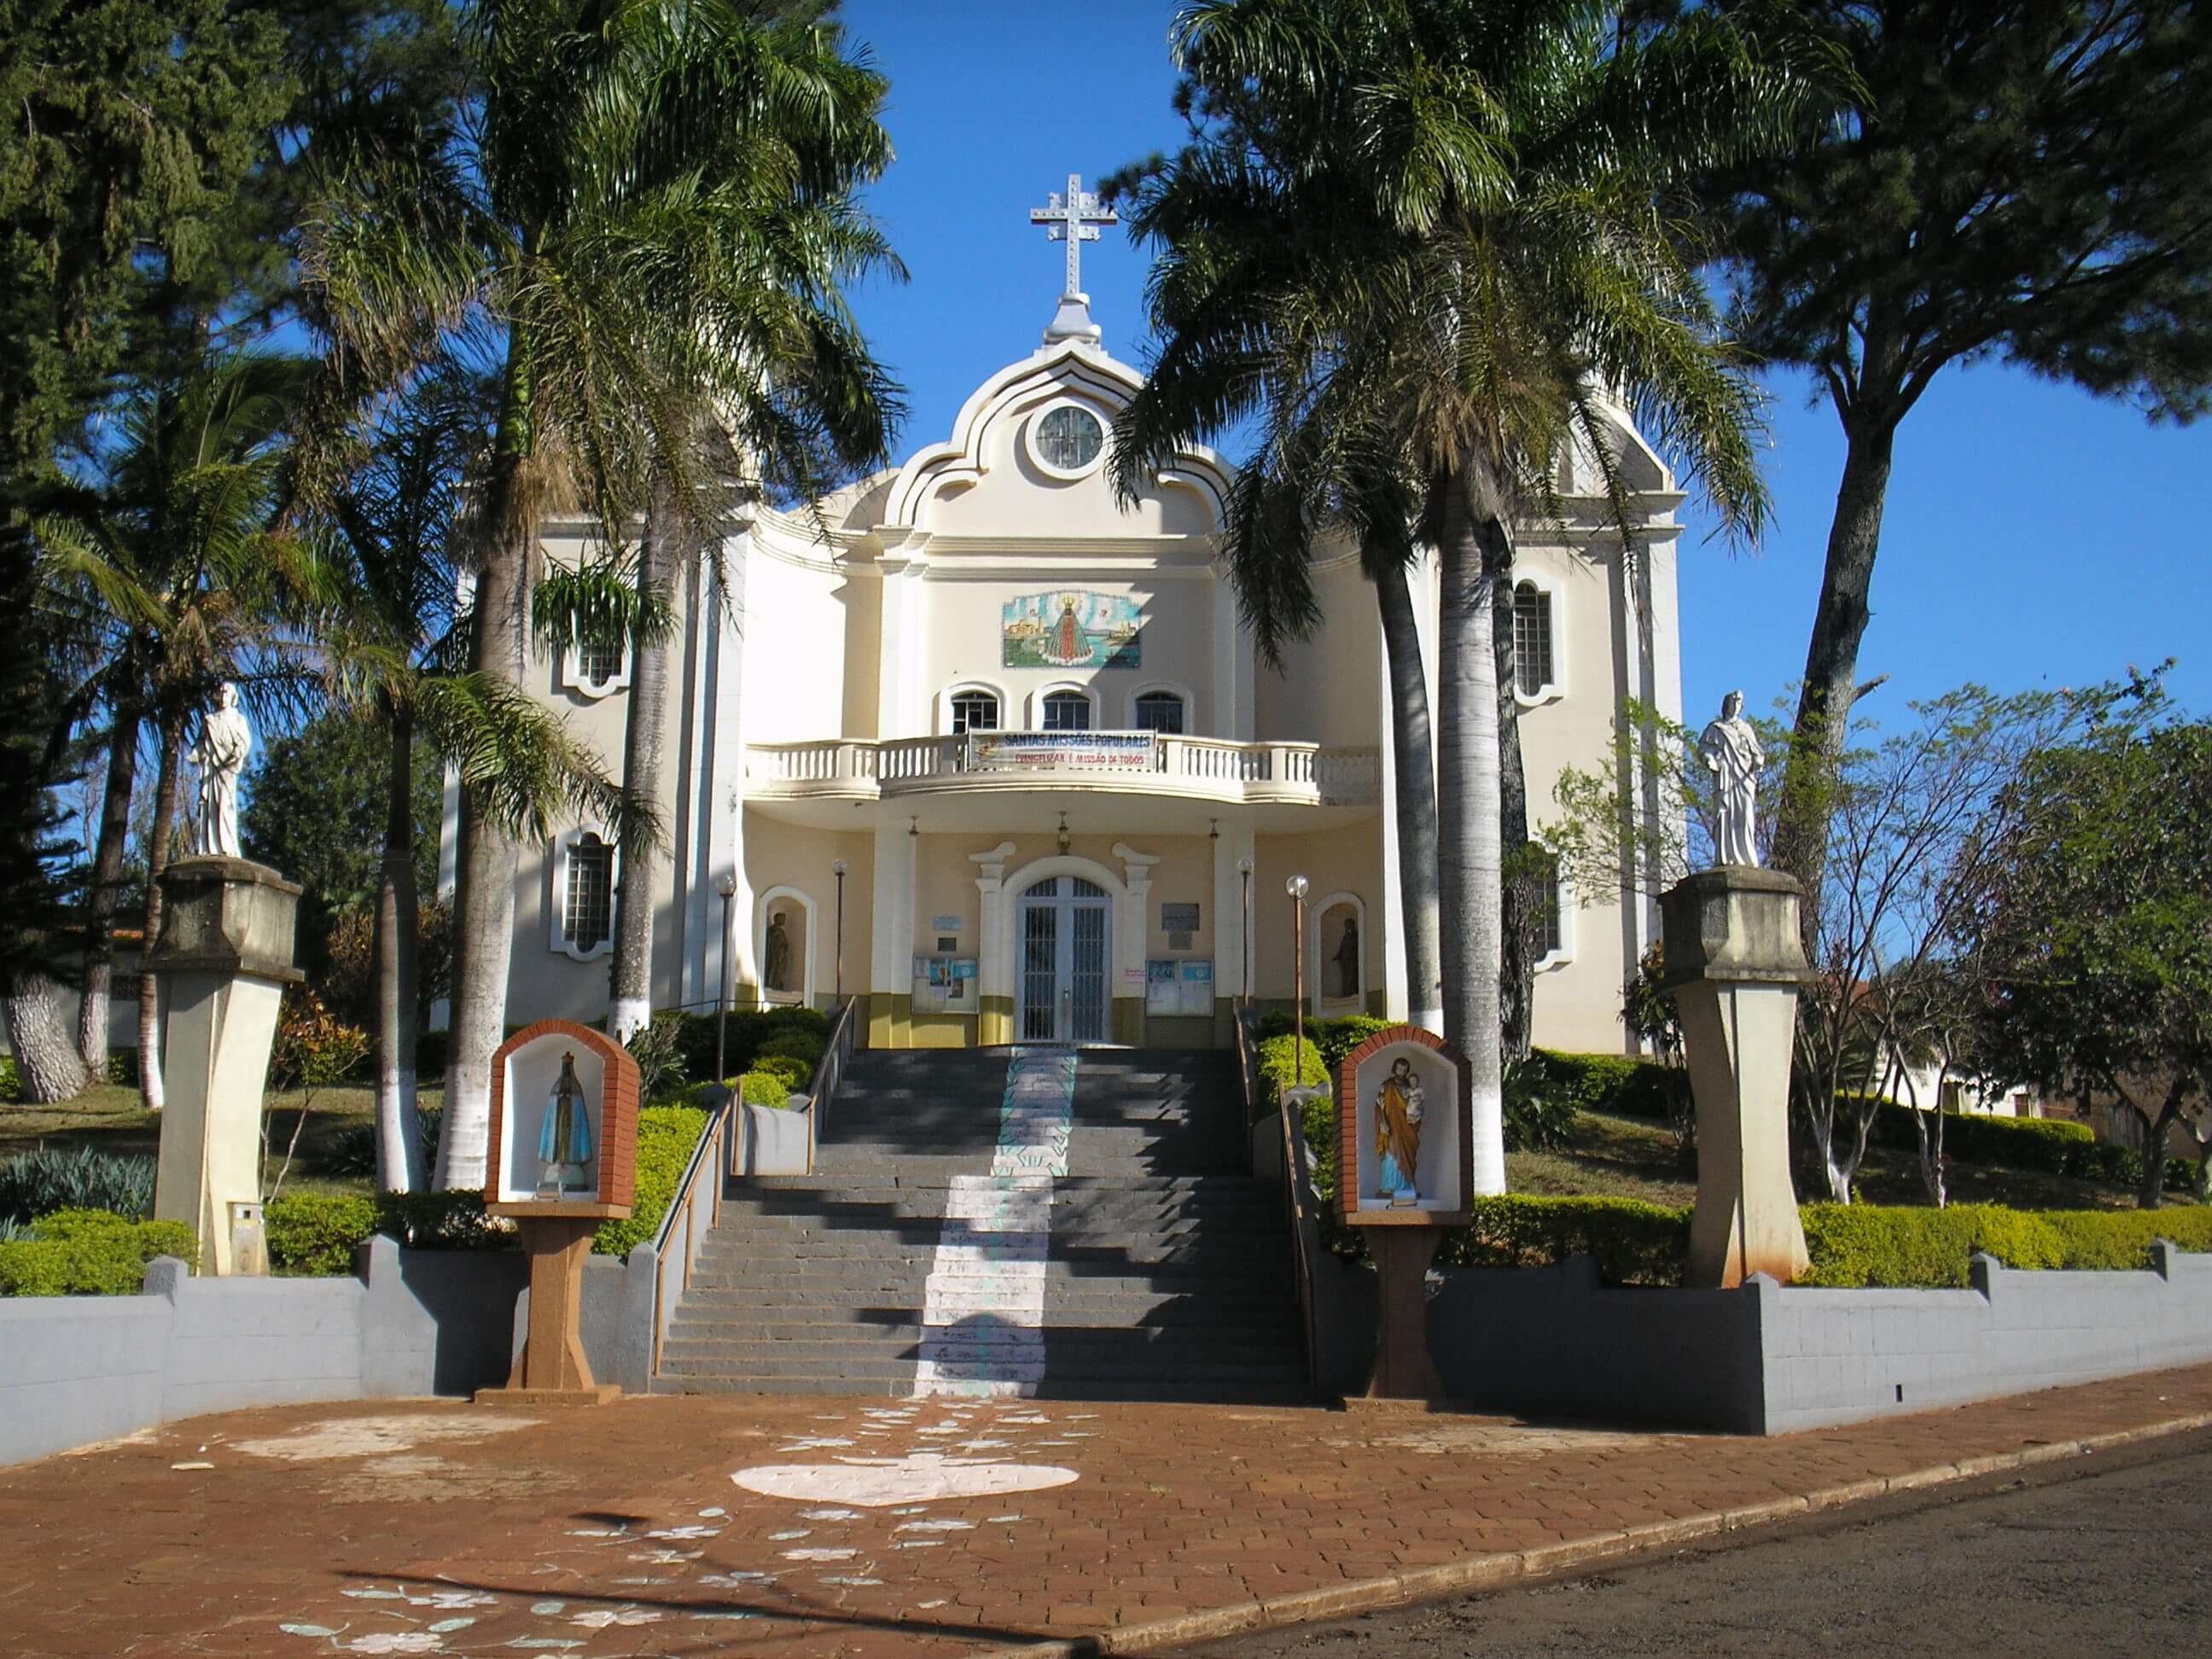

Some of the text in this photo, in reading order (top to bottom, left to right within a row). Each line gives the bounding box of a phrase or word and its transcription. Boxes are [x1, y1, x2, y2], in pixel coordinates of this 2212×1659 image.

[1004, 734, 1045, 746] SANTAS
[1095, 735, 1150, 748] POPULARES
[1109, 754, 1116, 764] DE
[1120, 755, 1144, 765] TODOS
